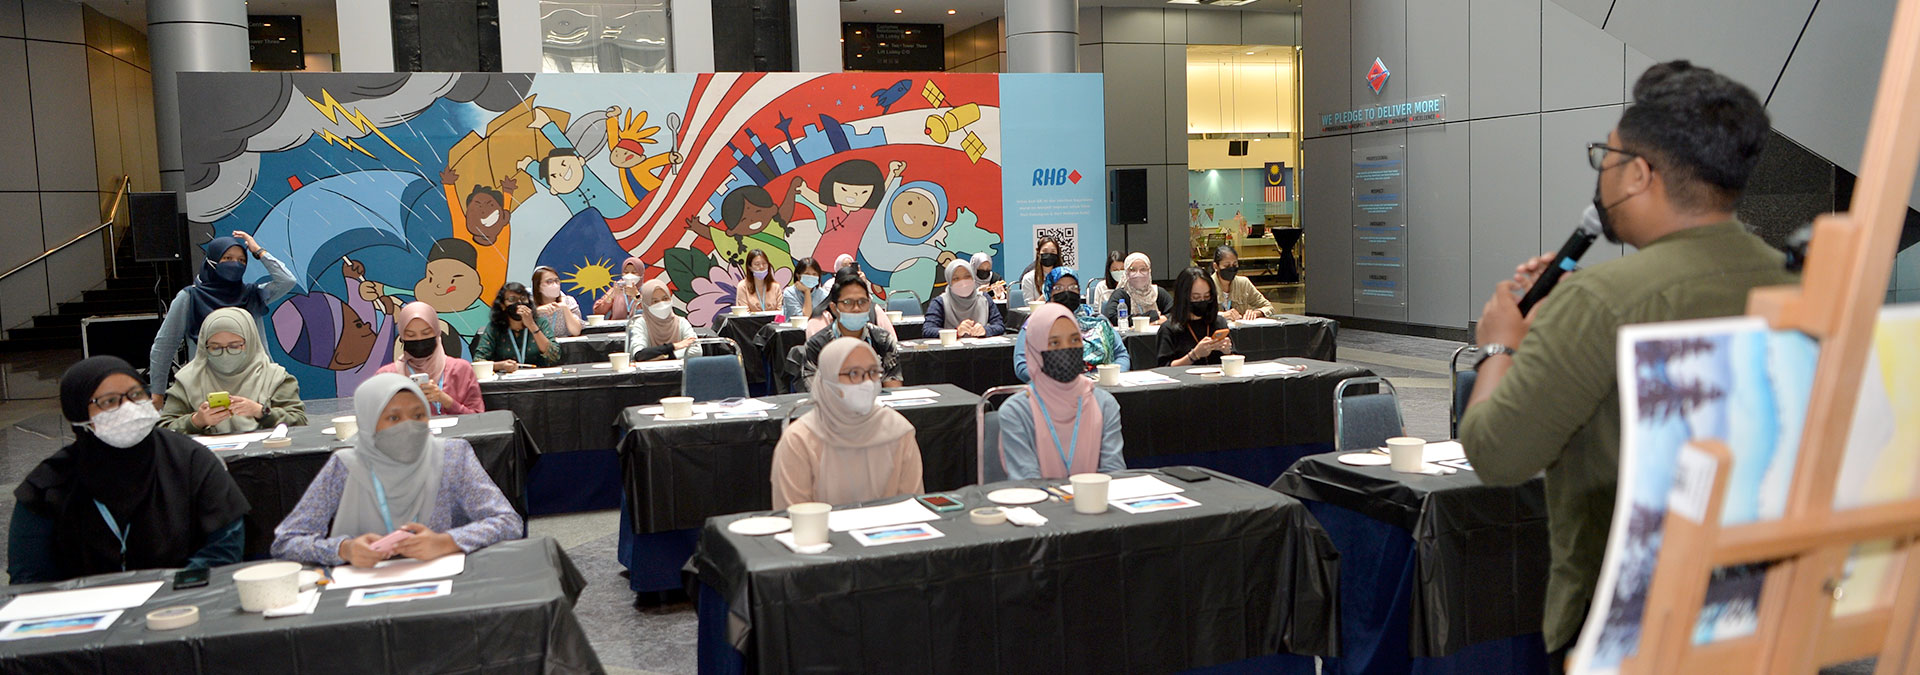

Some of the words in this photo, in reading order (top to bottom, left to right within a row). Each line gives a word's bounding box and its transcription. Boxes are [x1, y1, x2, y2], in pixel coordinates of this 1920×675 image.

[1322, 114, 1333, 126] WE
[1335, 110, 1362, 124] PLEDGE
[1364, 108, 1375, 120] TO
[1378, 103, 1412, 118] DELIVER
[1415, 99, 1440, 113] MORE
[1032, 168, 1068, 186] RHB
